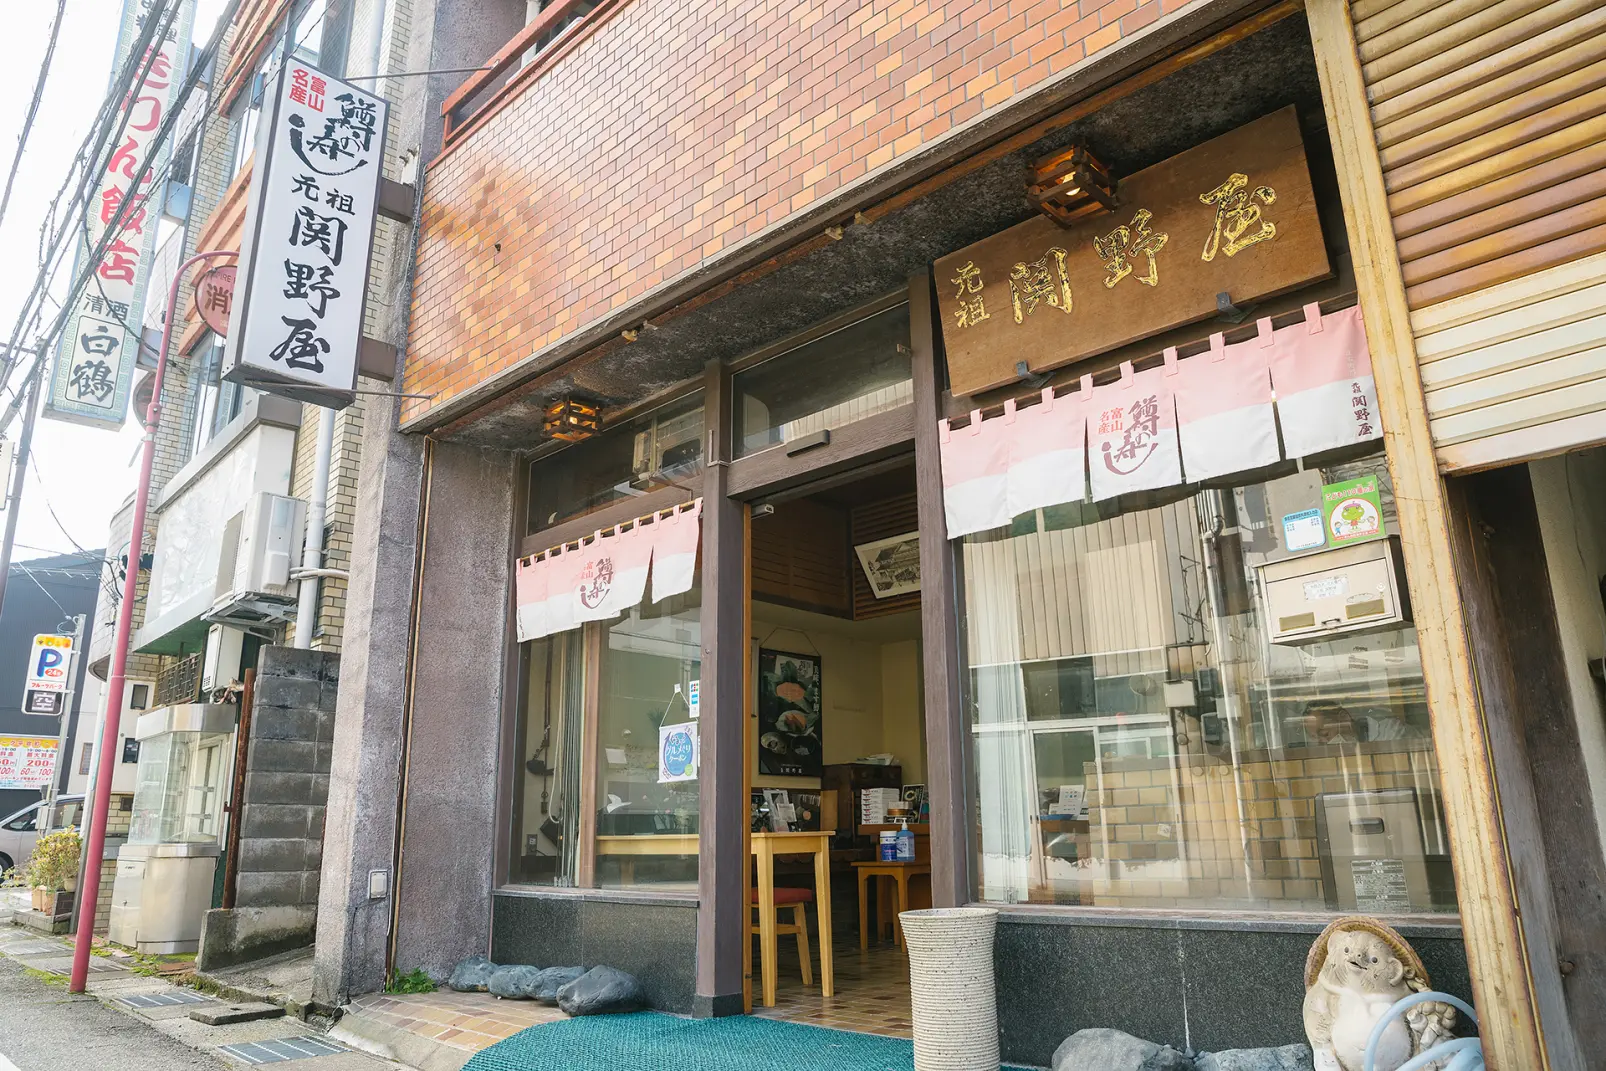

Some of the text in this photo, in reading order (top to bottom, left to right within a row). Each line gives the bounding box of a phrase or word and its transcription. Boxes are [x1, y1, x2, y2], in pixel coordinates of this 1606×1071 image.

[289, 68, 309, 105] 名産
[306, 75, 327, 113] 富山
[291, 173, 356, 215] 元祖
[1008, 172, 1277, 325] 関野屋
[83, 292, 130, 321] 清酒
[205, 283, 233, 315] 消
[269, 205, 348, 374] 関野屋
[951, 260, 991, 328] 元祖
[70, 325, 120, 401] 白鶴
[1352, 395, 1373, 437] 関野屋
[32, 692, 56, 711] 空
